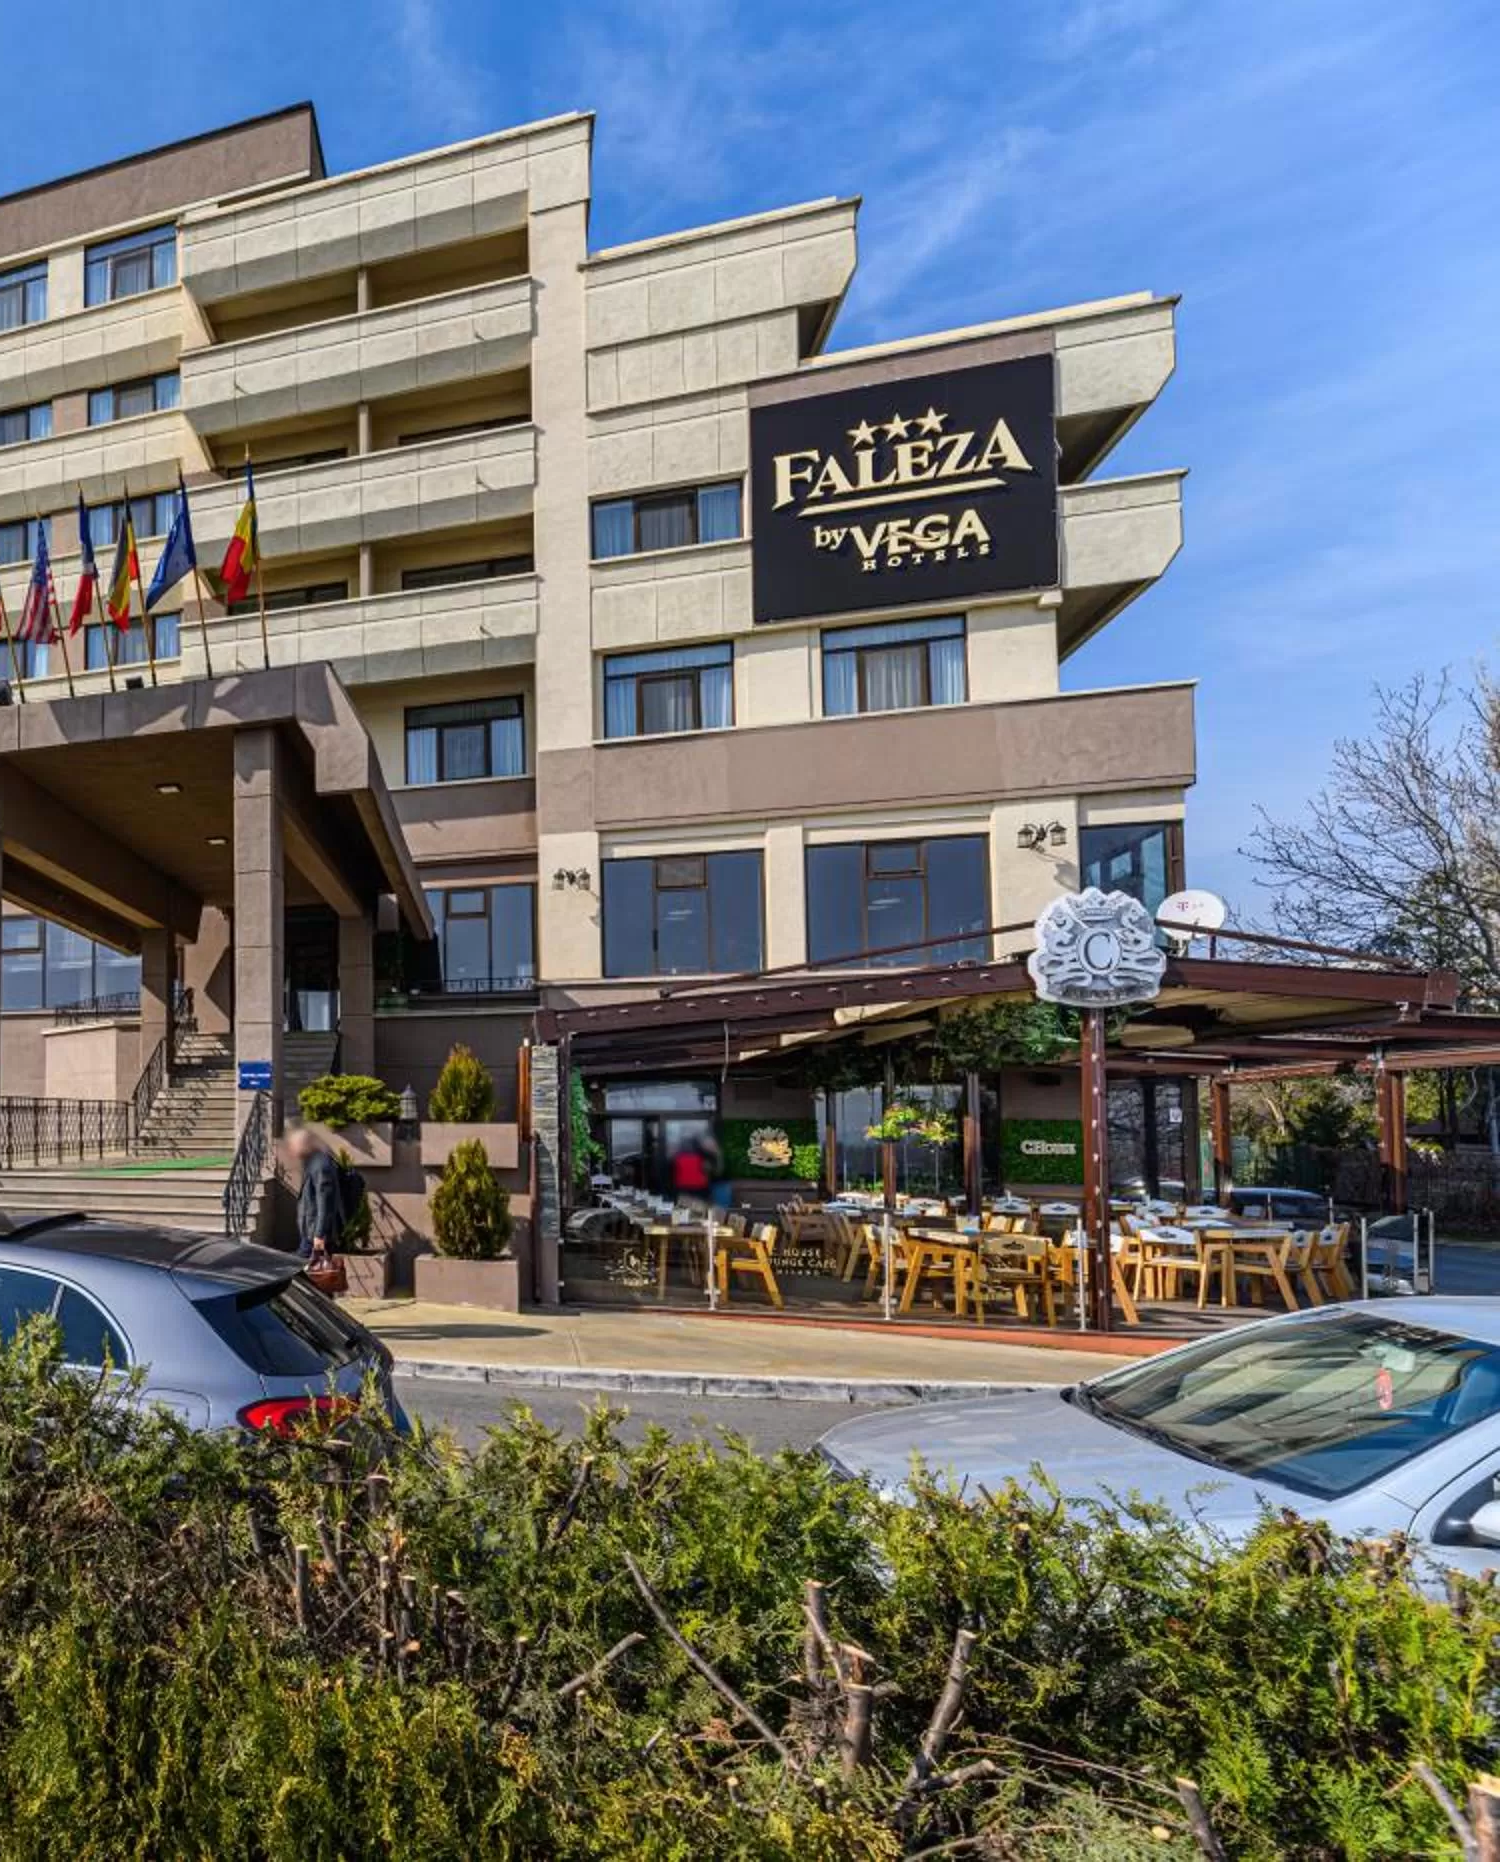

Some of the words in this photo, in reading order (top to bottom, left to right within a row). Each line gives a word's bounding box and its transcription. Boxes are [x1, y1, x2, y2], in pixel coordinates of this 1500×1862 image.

[771, 417, 1034, 511] FALEZA
[813, 525, 849, 551] by
[849, 508, 991, 560] VEGA
[861, 542, 991, 573] HOTELS
